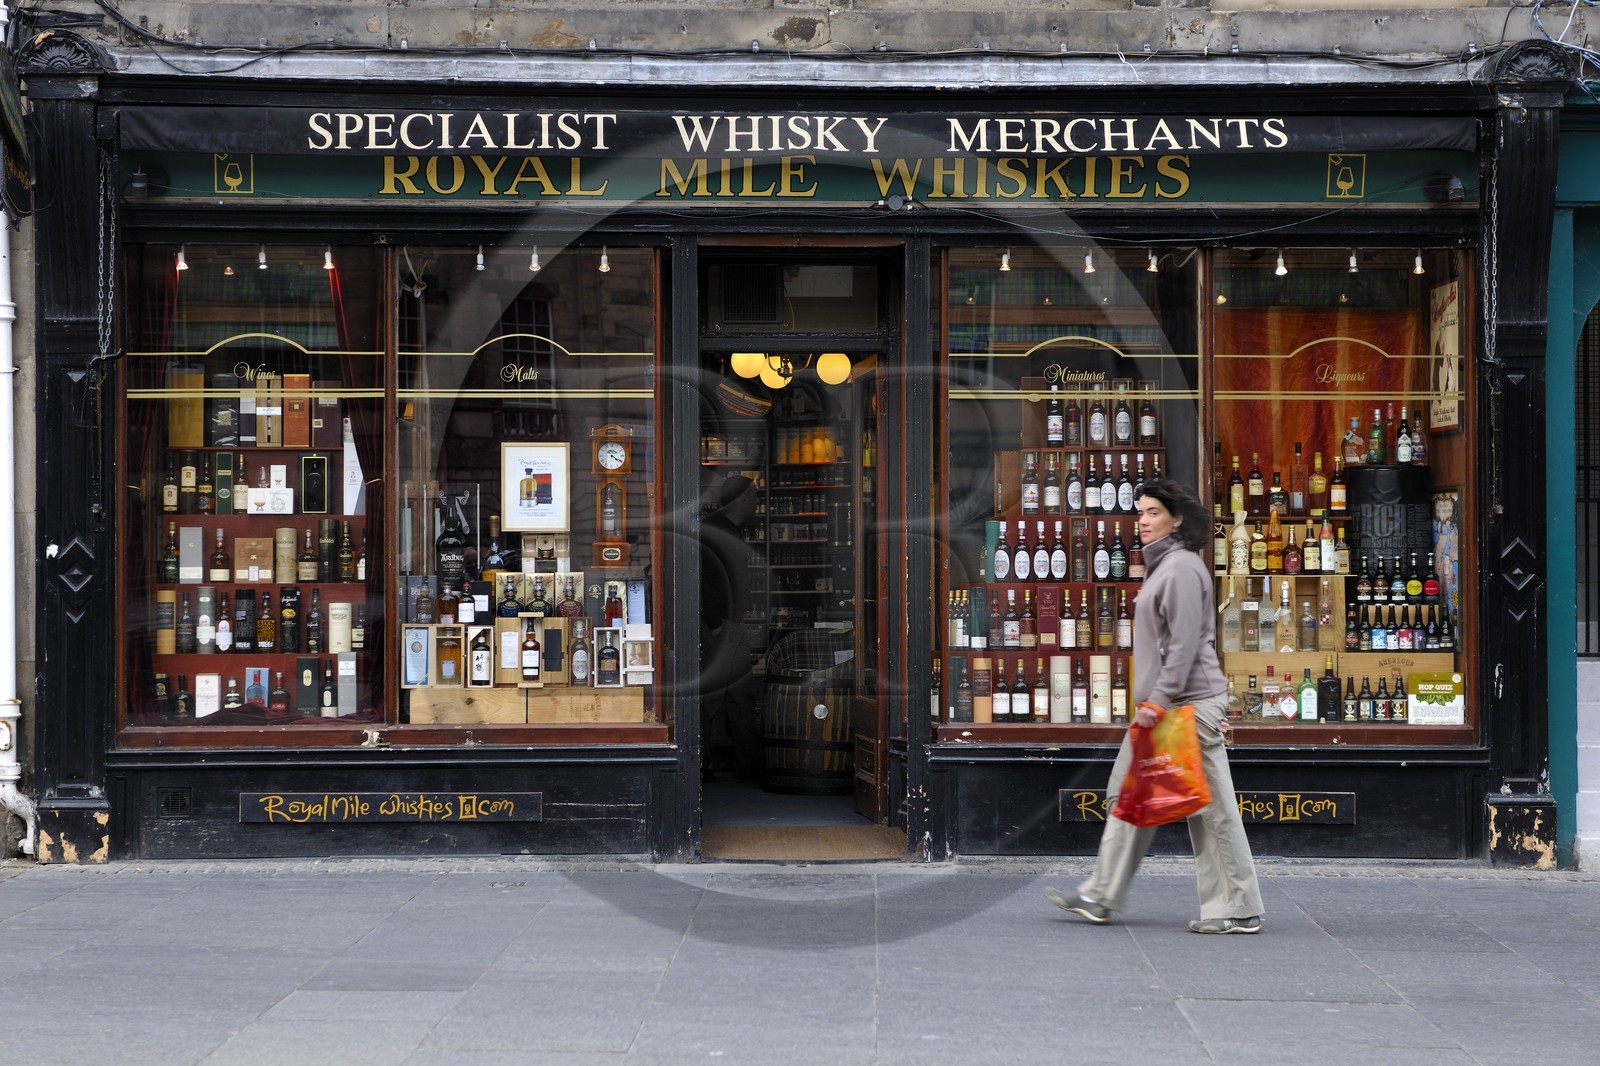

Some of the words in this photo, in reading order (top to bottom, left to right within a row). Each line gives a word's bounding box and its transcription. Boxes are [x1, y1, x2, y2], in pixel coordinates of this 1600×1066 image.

[307, 111, 619, 152] SPECIALIST
[671, 114, 890, 155] WHISKY
[946, 116, 1289, 155] MERCHANTS
[378, 155, 609, 198] ROYAL
[657, 155, 820, 199] MILE
[872, 154, 1192, 201] WHISKIES
[233, 361, 276, 382] Wines
[500, 363, 539, 383] Malts
[1043, 363, 1106, 384] Miniatures
[1315, 363, 1366, 387] Liqueurs
[1378, 656, 1415, 667] ABERLOUR
[259, 795, 329, 823] Royal
[331, 795, 370, 820] Mile
